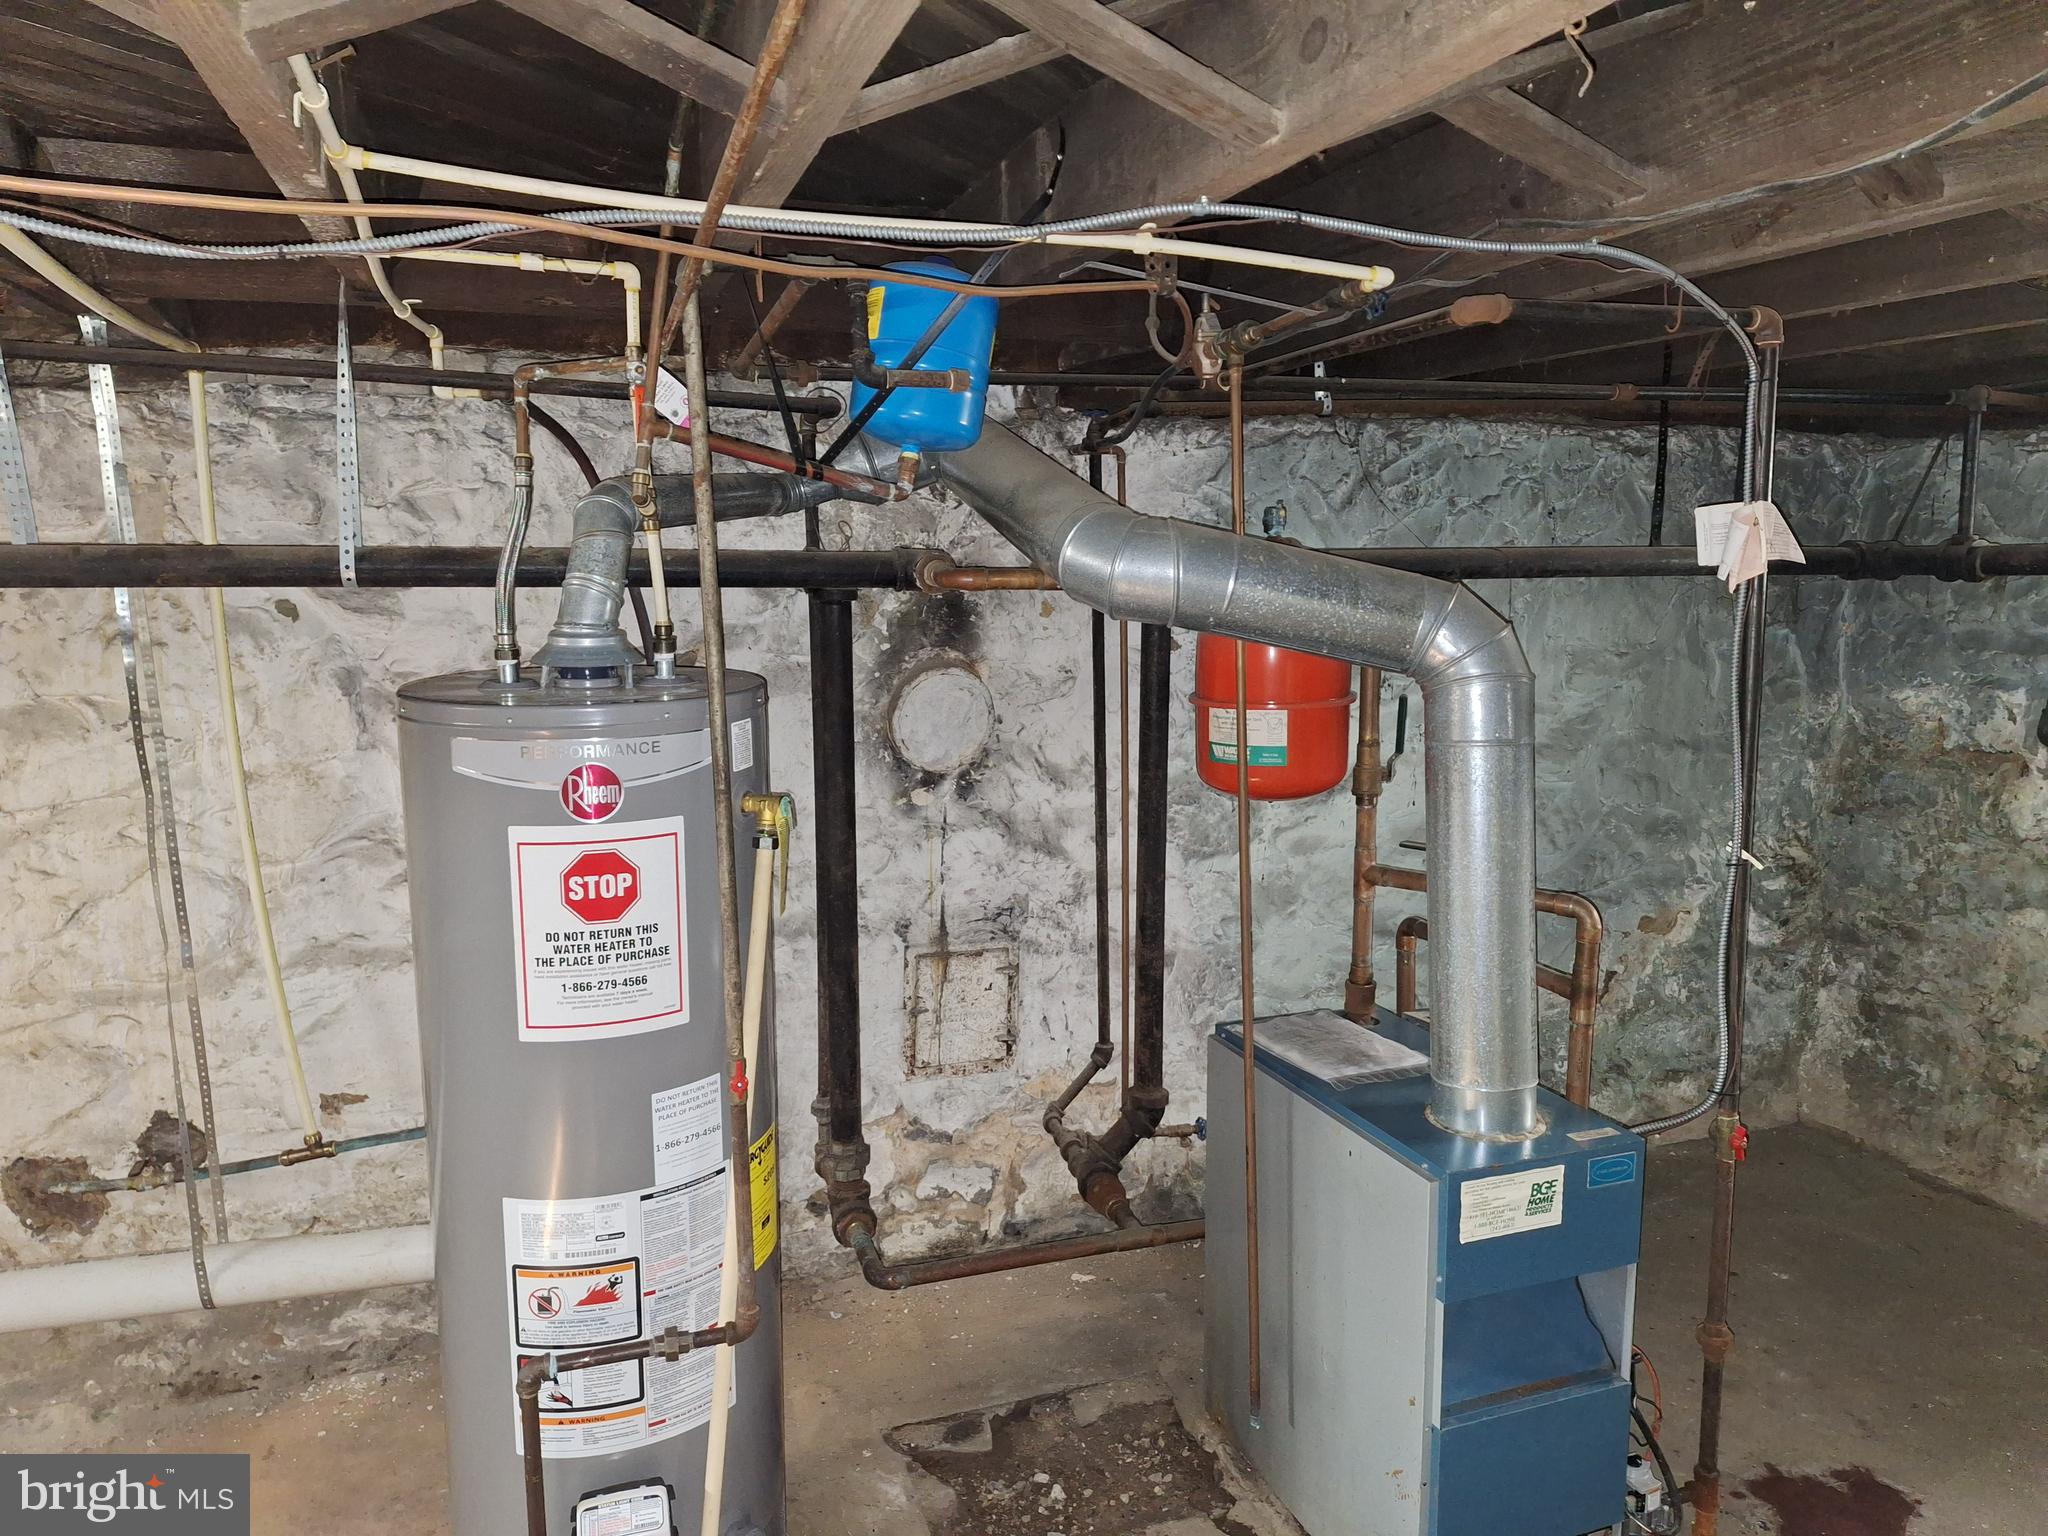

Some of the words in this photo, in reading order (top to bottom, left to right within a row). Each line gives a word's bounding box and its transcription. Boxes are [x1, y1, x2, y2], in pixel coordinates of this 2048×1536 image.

[520, 741, 661, 758] PERFORMANCE
[567, 764, 620, 813] Rheem
[568, 873, 632, 901] STOP
[545, 932, 560, 942] DO
[563, 931, 585, 942] NOT
[589, 927, 632, 940] RETURN
[635, 923, 659, 935] THIS
[553, 944, 591, 955] WATER
[594, 939, 636, 953] HEATER
[639, 936, 653, 946] TO
[534, 957, 556, 967] THE
[559, 956, 594, 967] PLACE
[597, 954, 612, 965] OF
[615, 945, 670, 963] PURCHASE
[561, 975, 648, 993] 1-866-279-4566
[654, 1103, 676, 1113] WATER
[677, 1095, 700, 1107] HEATER
[709, 1087, 719, 1095] THE
[667, 1093, 681, 1101] NOT
[681, 1085, 705, 1097] RETURN
[658, 1112, 677, 1121] PLACE
[688, 1098, 717, 1113] PURCHASE
[655, 1123, 721, 1152] 1-866-279-4566
[1530, 1179, 1559, 1198] BGE
[1527, 1194, 1557, 1207] HOME
[558, 1269, 601, 1278] WARNING
[569, 1416, 605, 1424] WARNING
